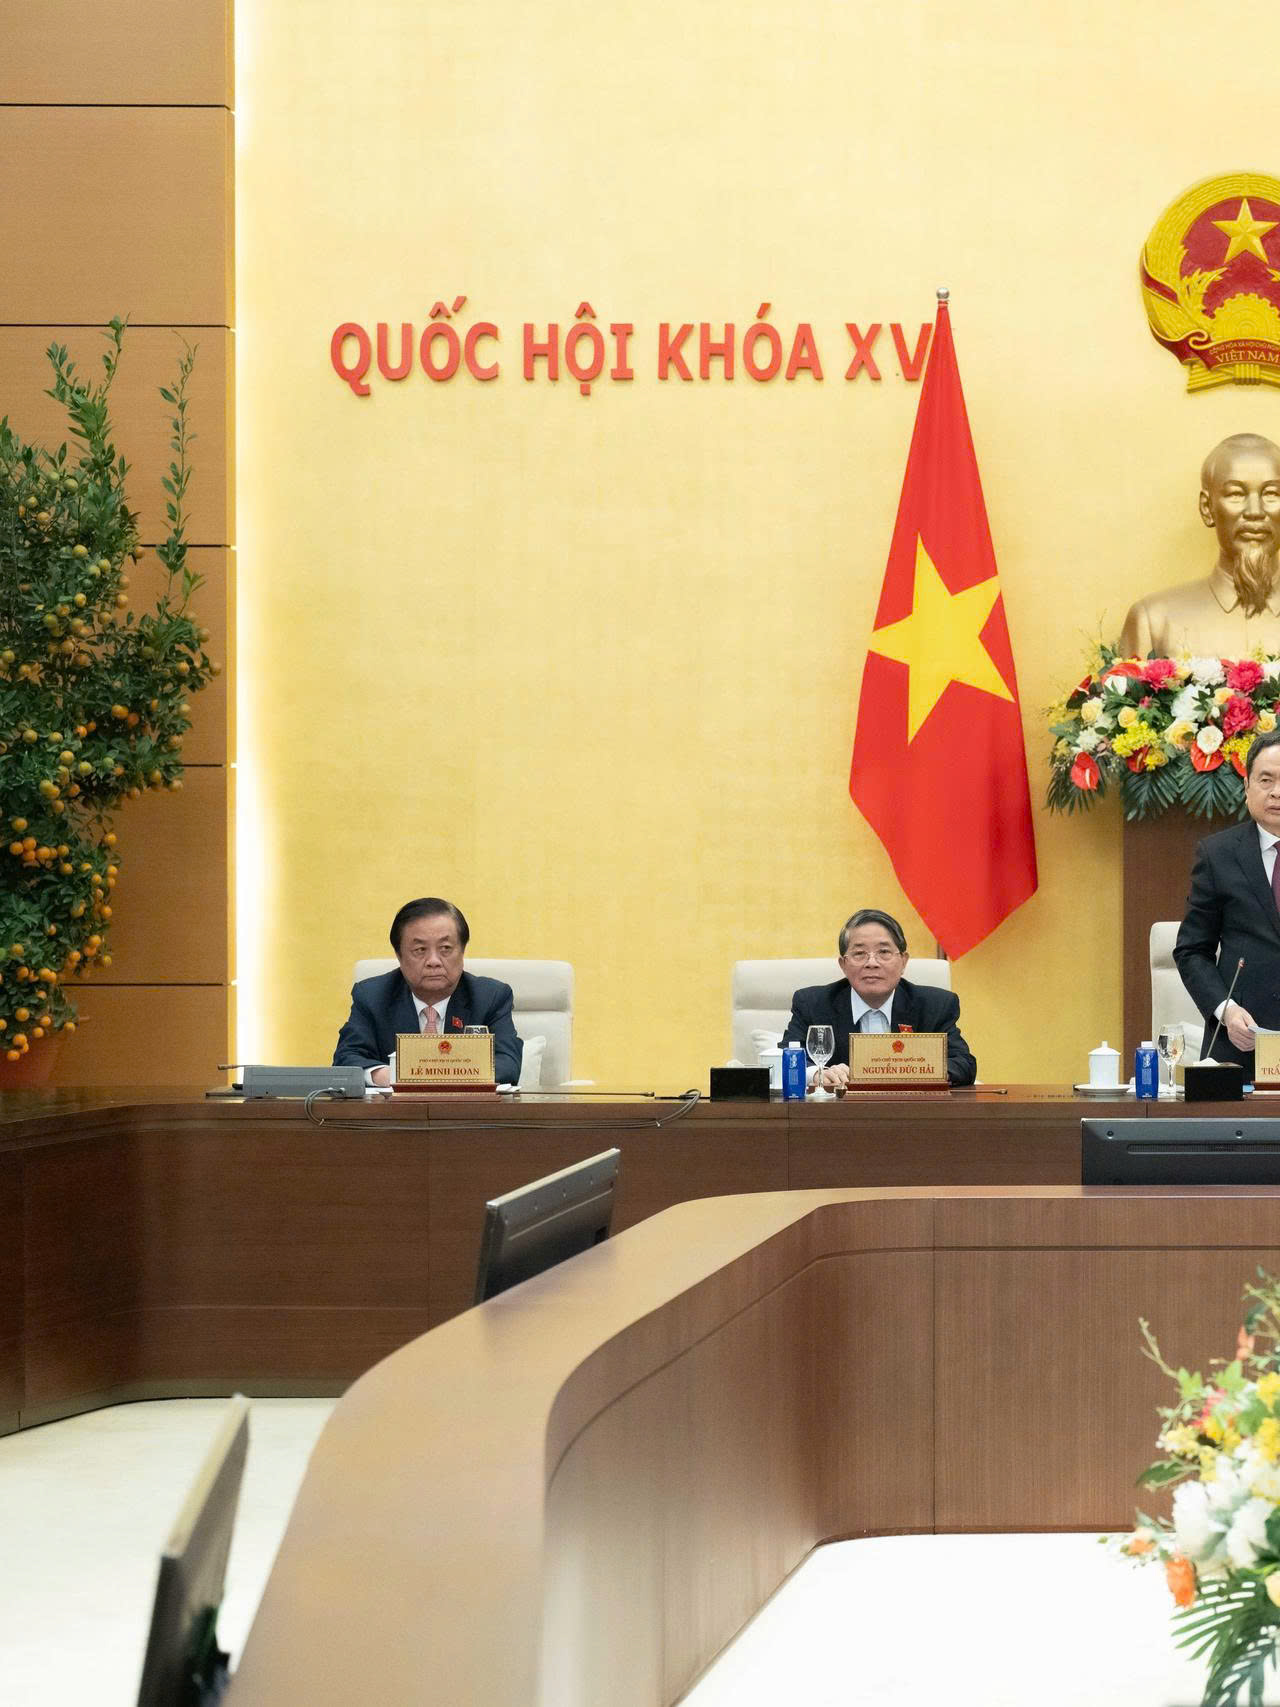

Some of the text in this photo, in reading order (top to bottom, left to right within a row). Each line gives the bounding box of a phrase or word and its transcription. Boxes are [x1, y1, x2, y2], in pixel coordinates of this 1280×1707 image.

[331, 296, 933, 396] QUỐC HỘI KHÓA XV
[1247, 350, 1280, 363] NAM
[425, 1067, 450, 1076] MINH
[453, 1067, 480, 1076] HOAN
